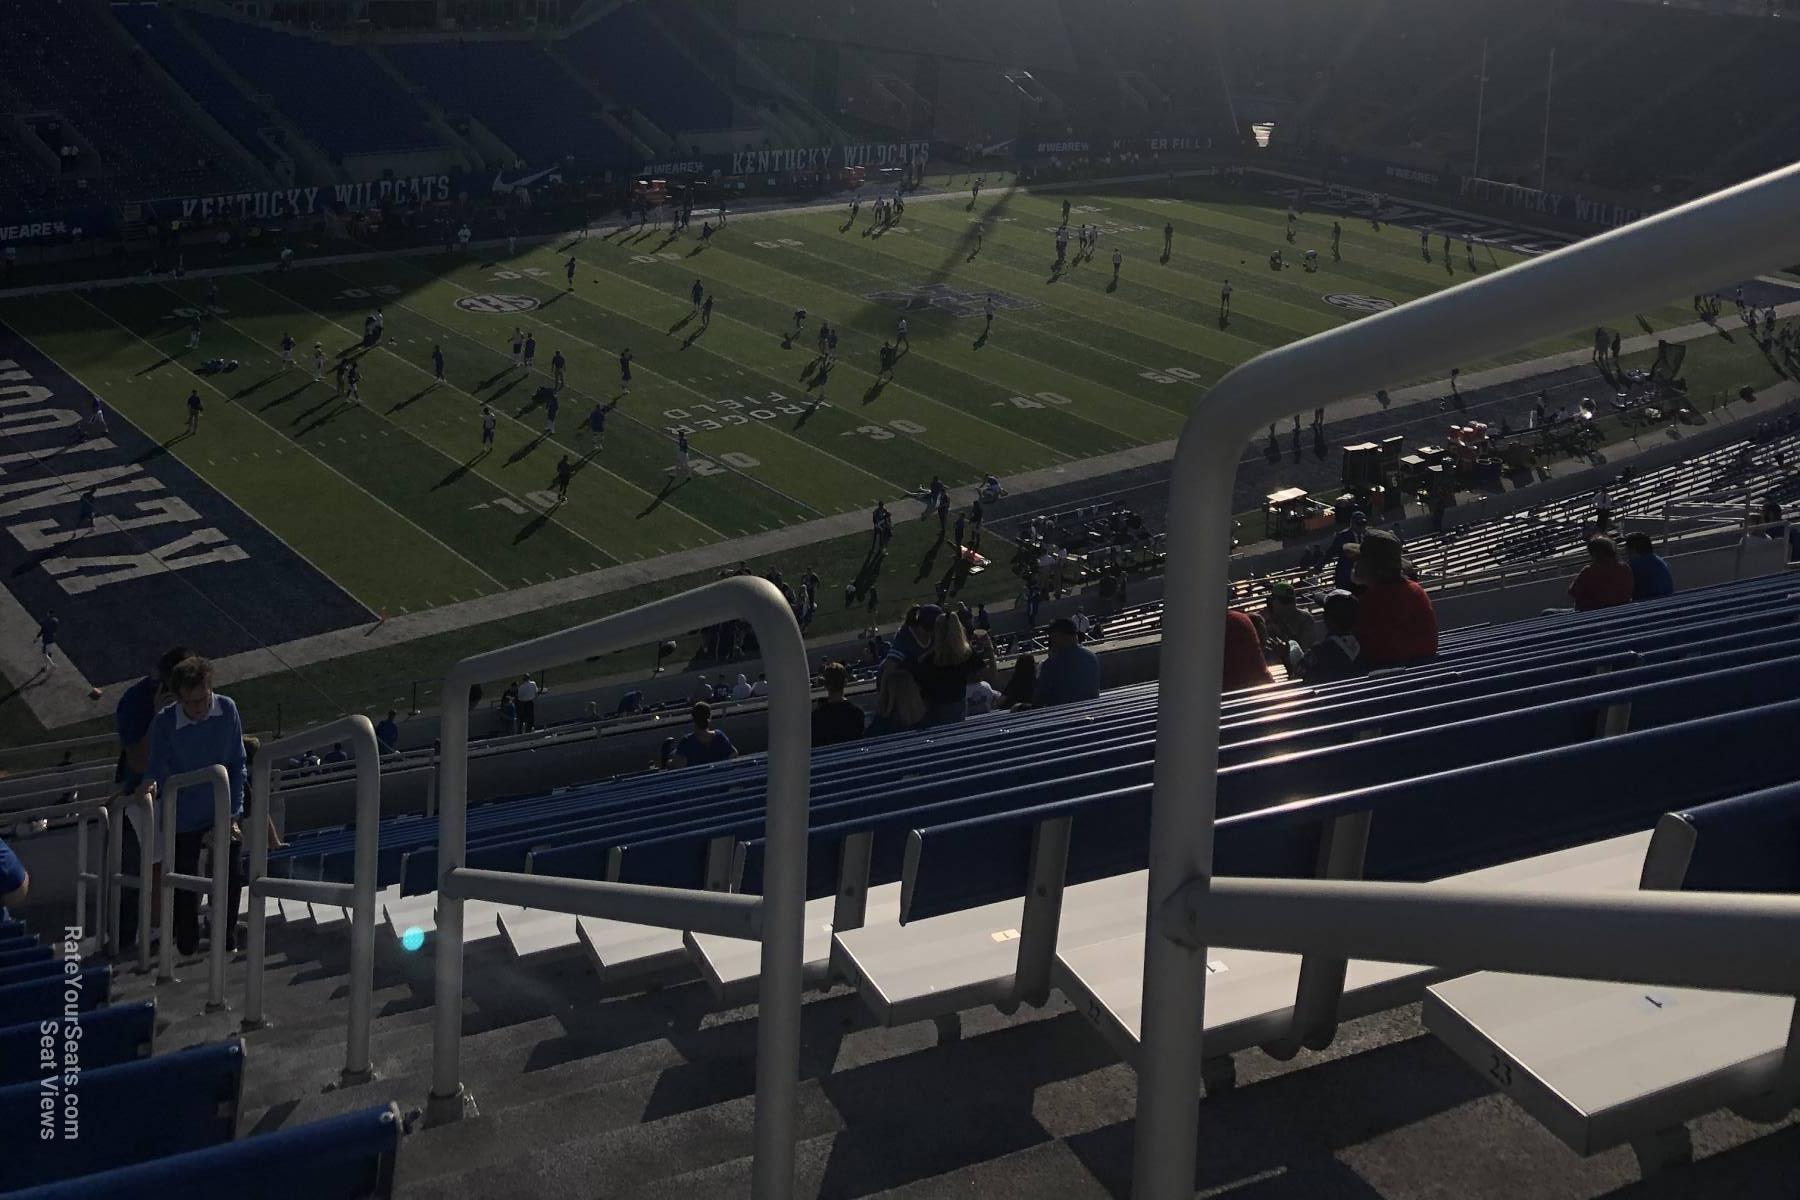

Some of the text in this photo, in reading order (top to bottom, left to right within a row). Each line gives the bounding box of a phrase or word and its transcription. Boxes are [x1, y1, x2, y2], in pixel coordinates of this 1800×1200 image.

[732, 143, 930, 175] KENTUCKY WILDCATS
[182, 175, 450, 218] KENTUCKY WILDCATS
[1139, 366, 1200, 384] 50
[1009, 391, 1073, 409] 40
[856, 419, 928, 441] 30
[1490, 1053, 1512, 1086] 23
